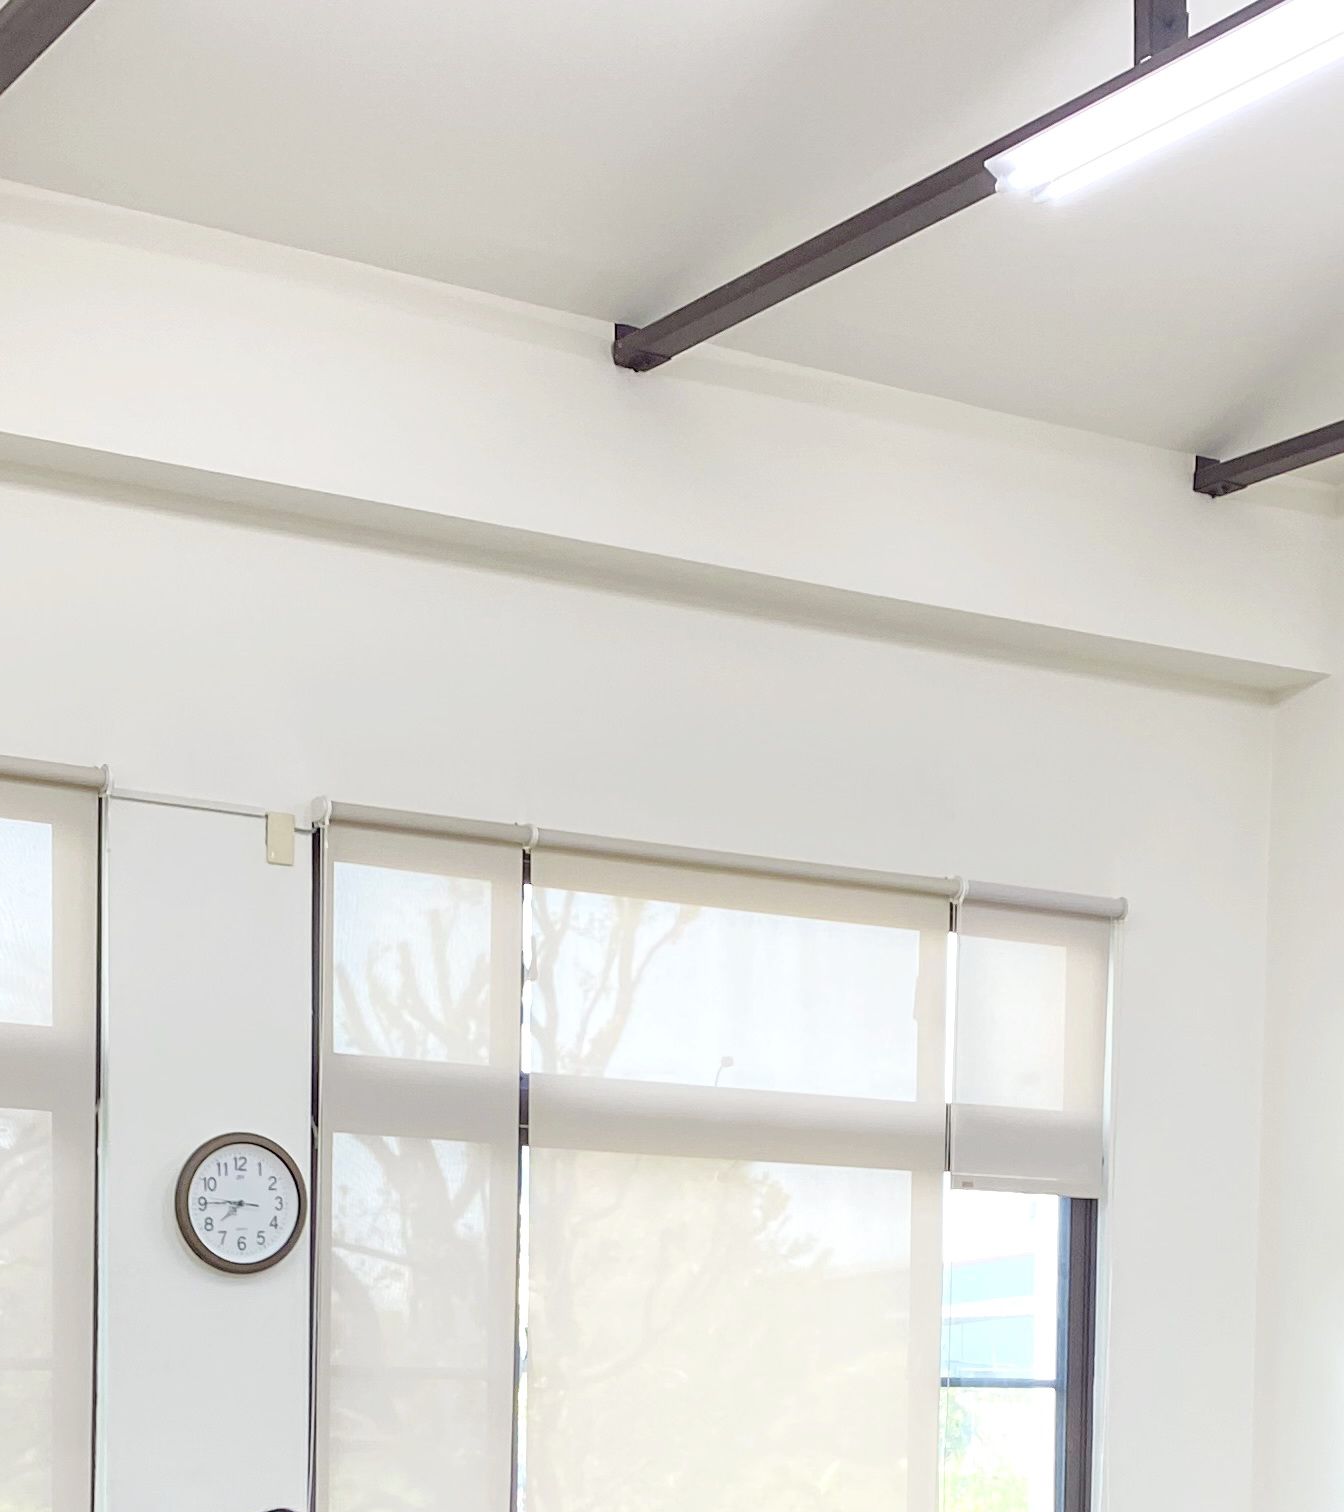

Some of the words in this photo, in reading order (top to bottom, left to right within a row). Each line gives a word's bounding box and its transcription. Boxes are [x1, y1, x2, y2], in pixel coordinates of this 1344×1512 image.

[217, 1162, 229, 1176] 11
[233, 1156, 248, 1172] 12
[203, 1177, 217, 1192] 10
[268, 1176, 277, 1191] 2
[197, 1196, 208, 1211] 9
[274, 1196, 284, 1211] 3
[204, 1217, 214, 1232] 8
[269, 1216, 278, 1230] 4
[218, 1230, 227, 1245] 7
[237, 1236, 247, 1251] 6
[256, 1231, 266, 1246] 5
